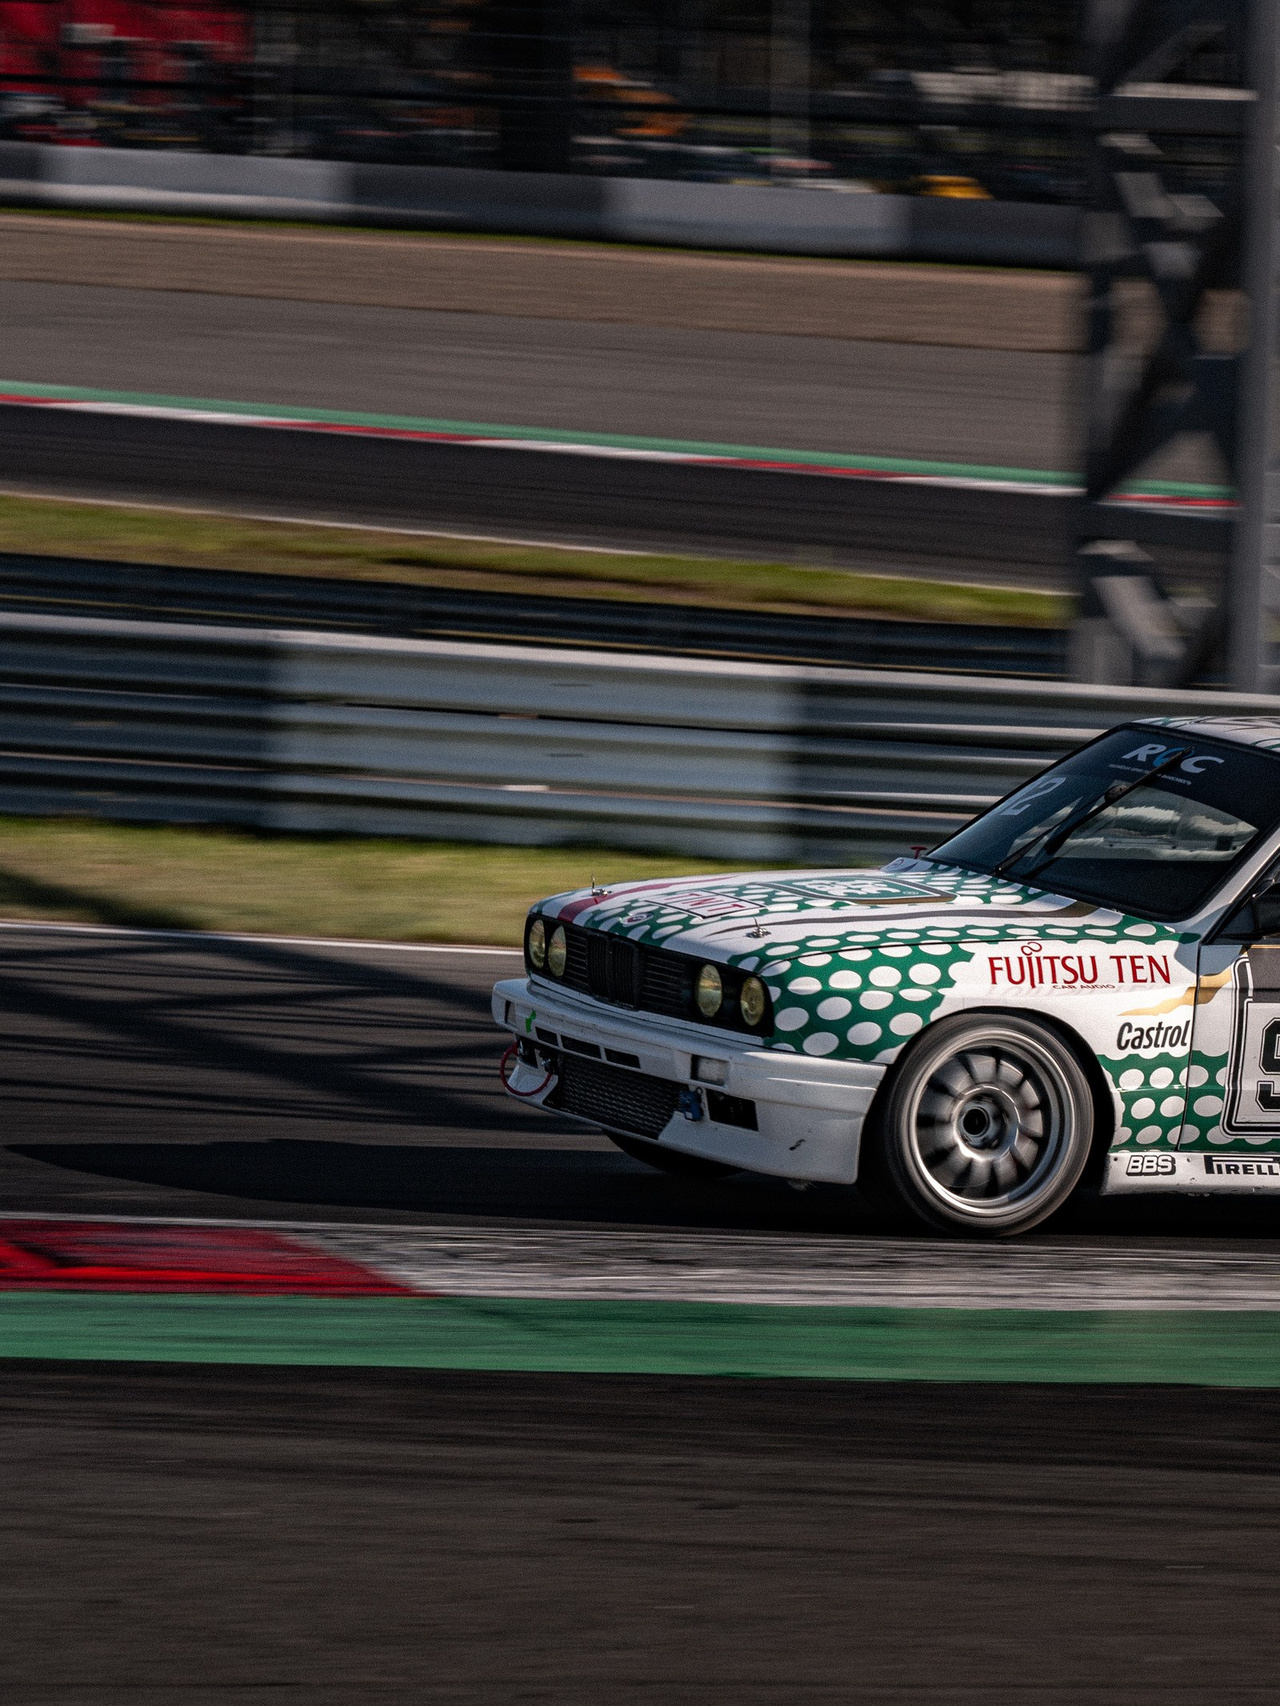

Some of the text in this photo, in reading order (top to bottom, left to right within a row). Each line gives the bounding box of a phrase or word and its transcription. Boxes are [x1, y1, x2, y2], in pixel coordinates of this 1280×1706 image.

[987, 954, 1171, 989] FUJITSU TEN
[1116, 1019, 1191, 1051] Castrol
[1125, 1154, 1177, 1177] BBS
